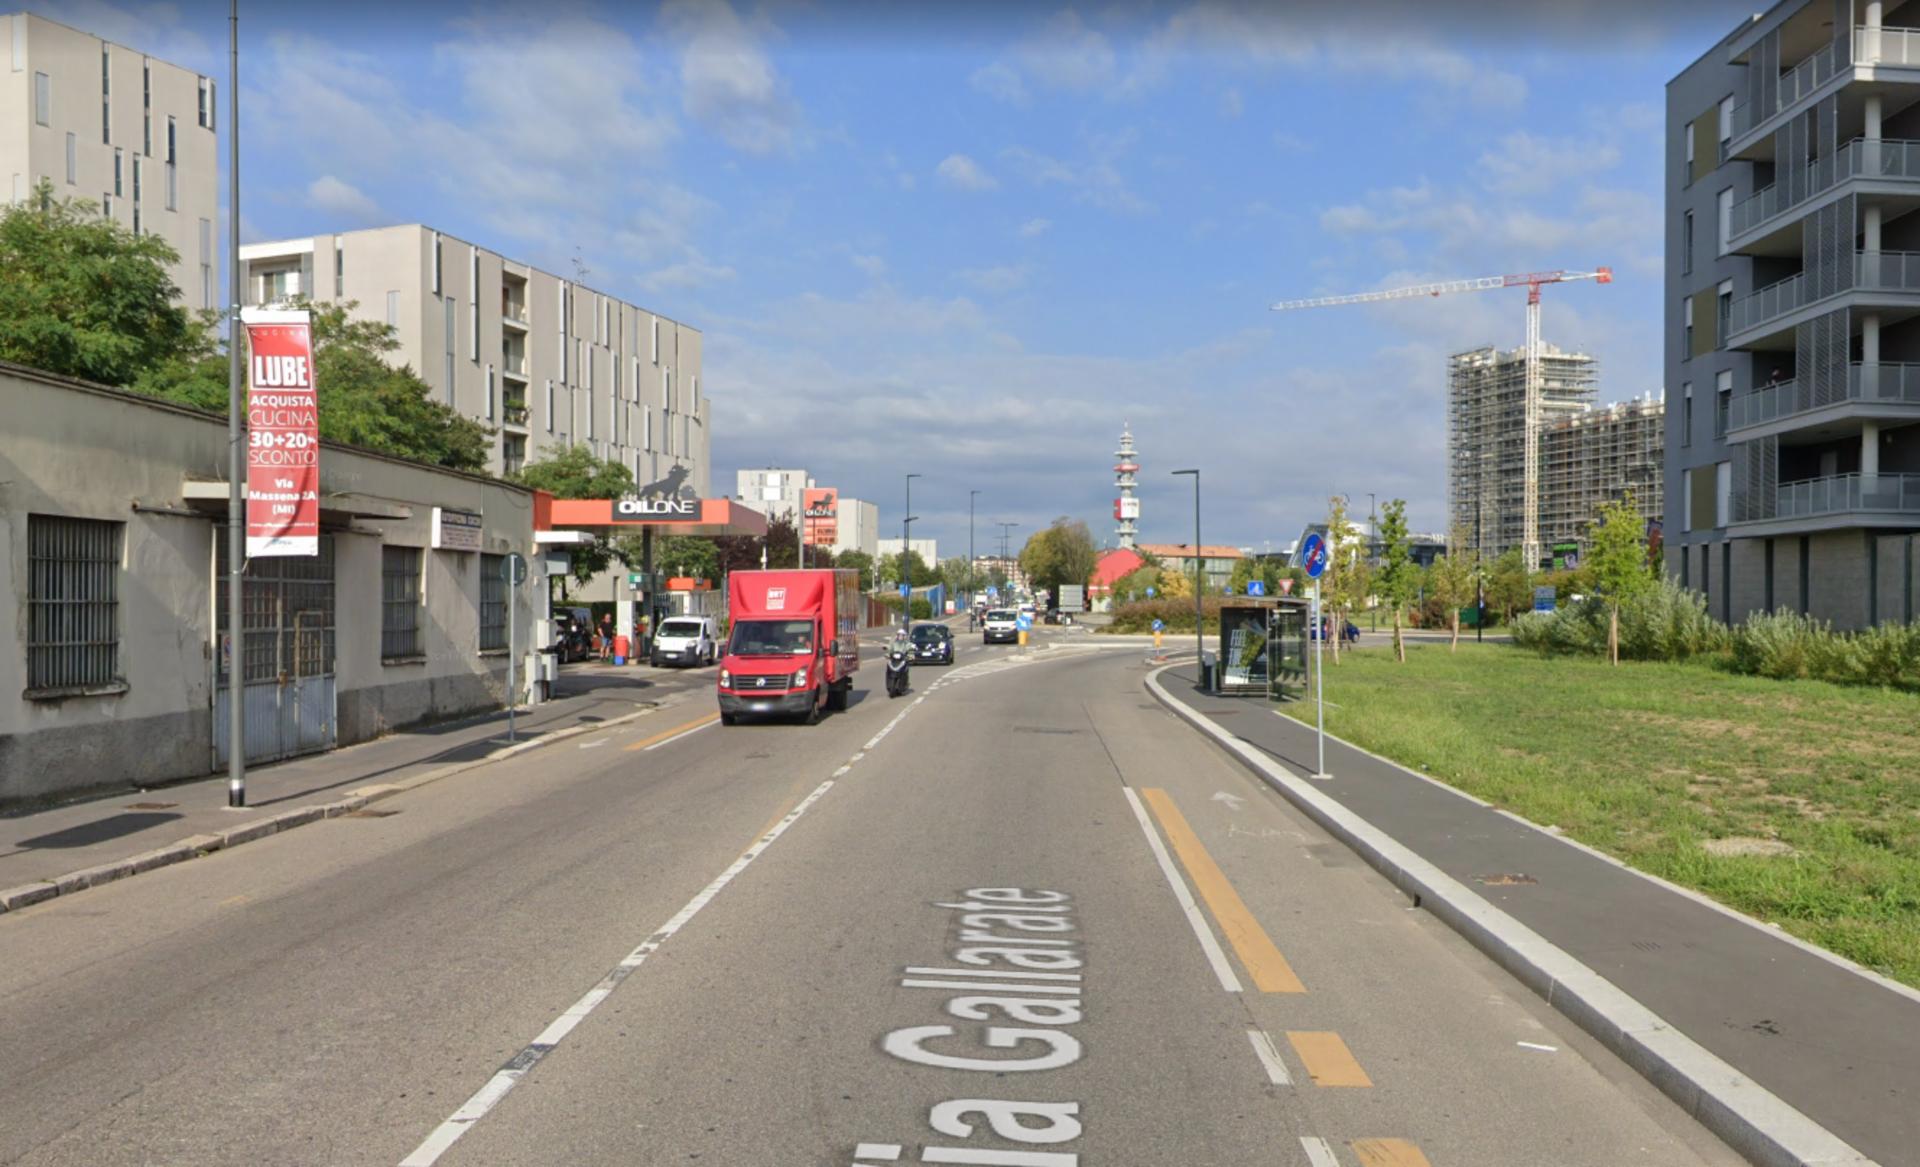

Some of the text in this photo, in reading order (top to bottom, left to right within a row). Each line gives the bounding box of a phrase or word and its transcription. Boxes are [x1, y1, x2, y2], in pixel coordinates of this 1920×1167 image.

[255, 356, 308, 386] LUBE
[250, 395, 314, 408] ACQUISTA
[249, 409, 315, 426] CUCINA
[249, 450, 316, 464] SCONTO
[274, 478, 294, 488] Via
[249, 490, 300, 501] Massena
[272, 503, 296, 515] (MI)
[618, 499, 695, 514] OILONE
[852, 887, 1082, 1167] ia Gallarate
